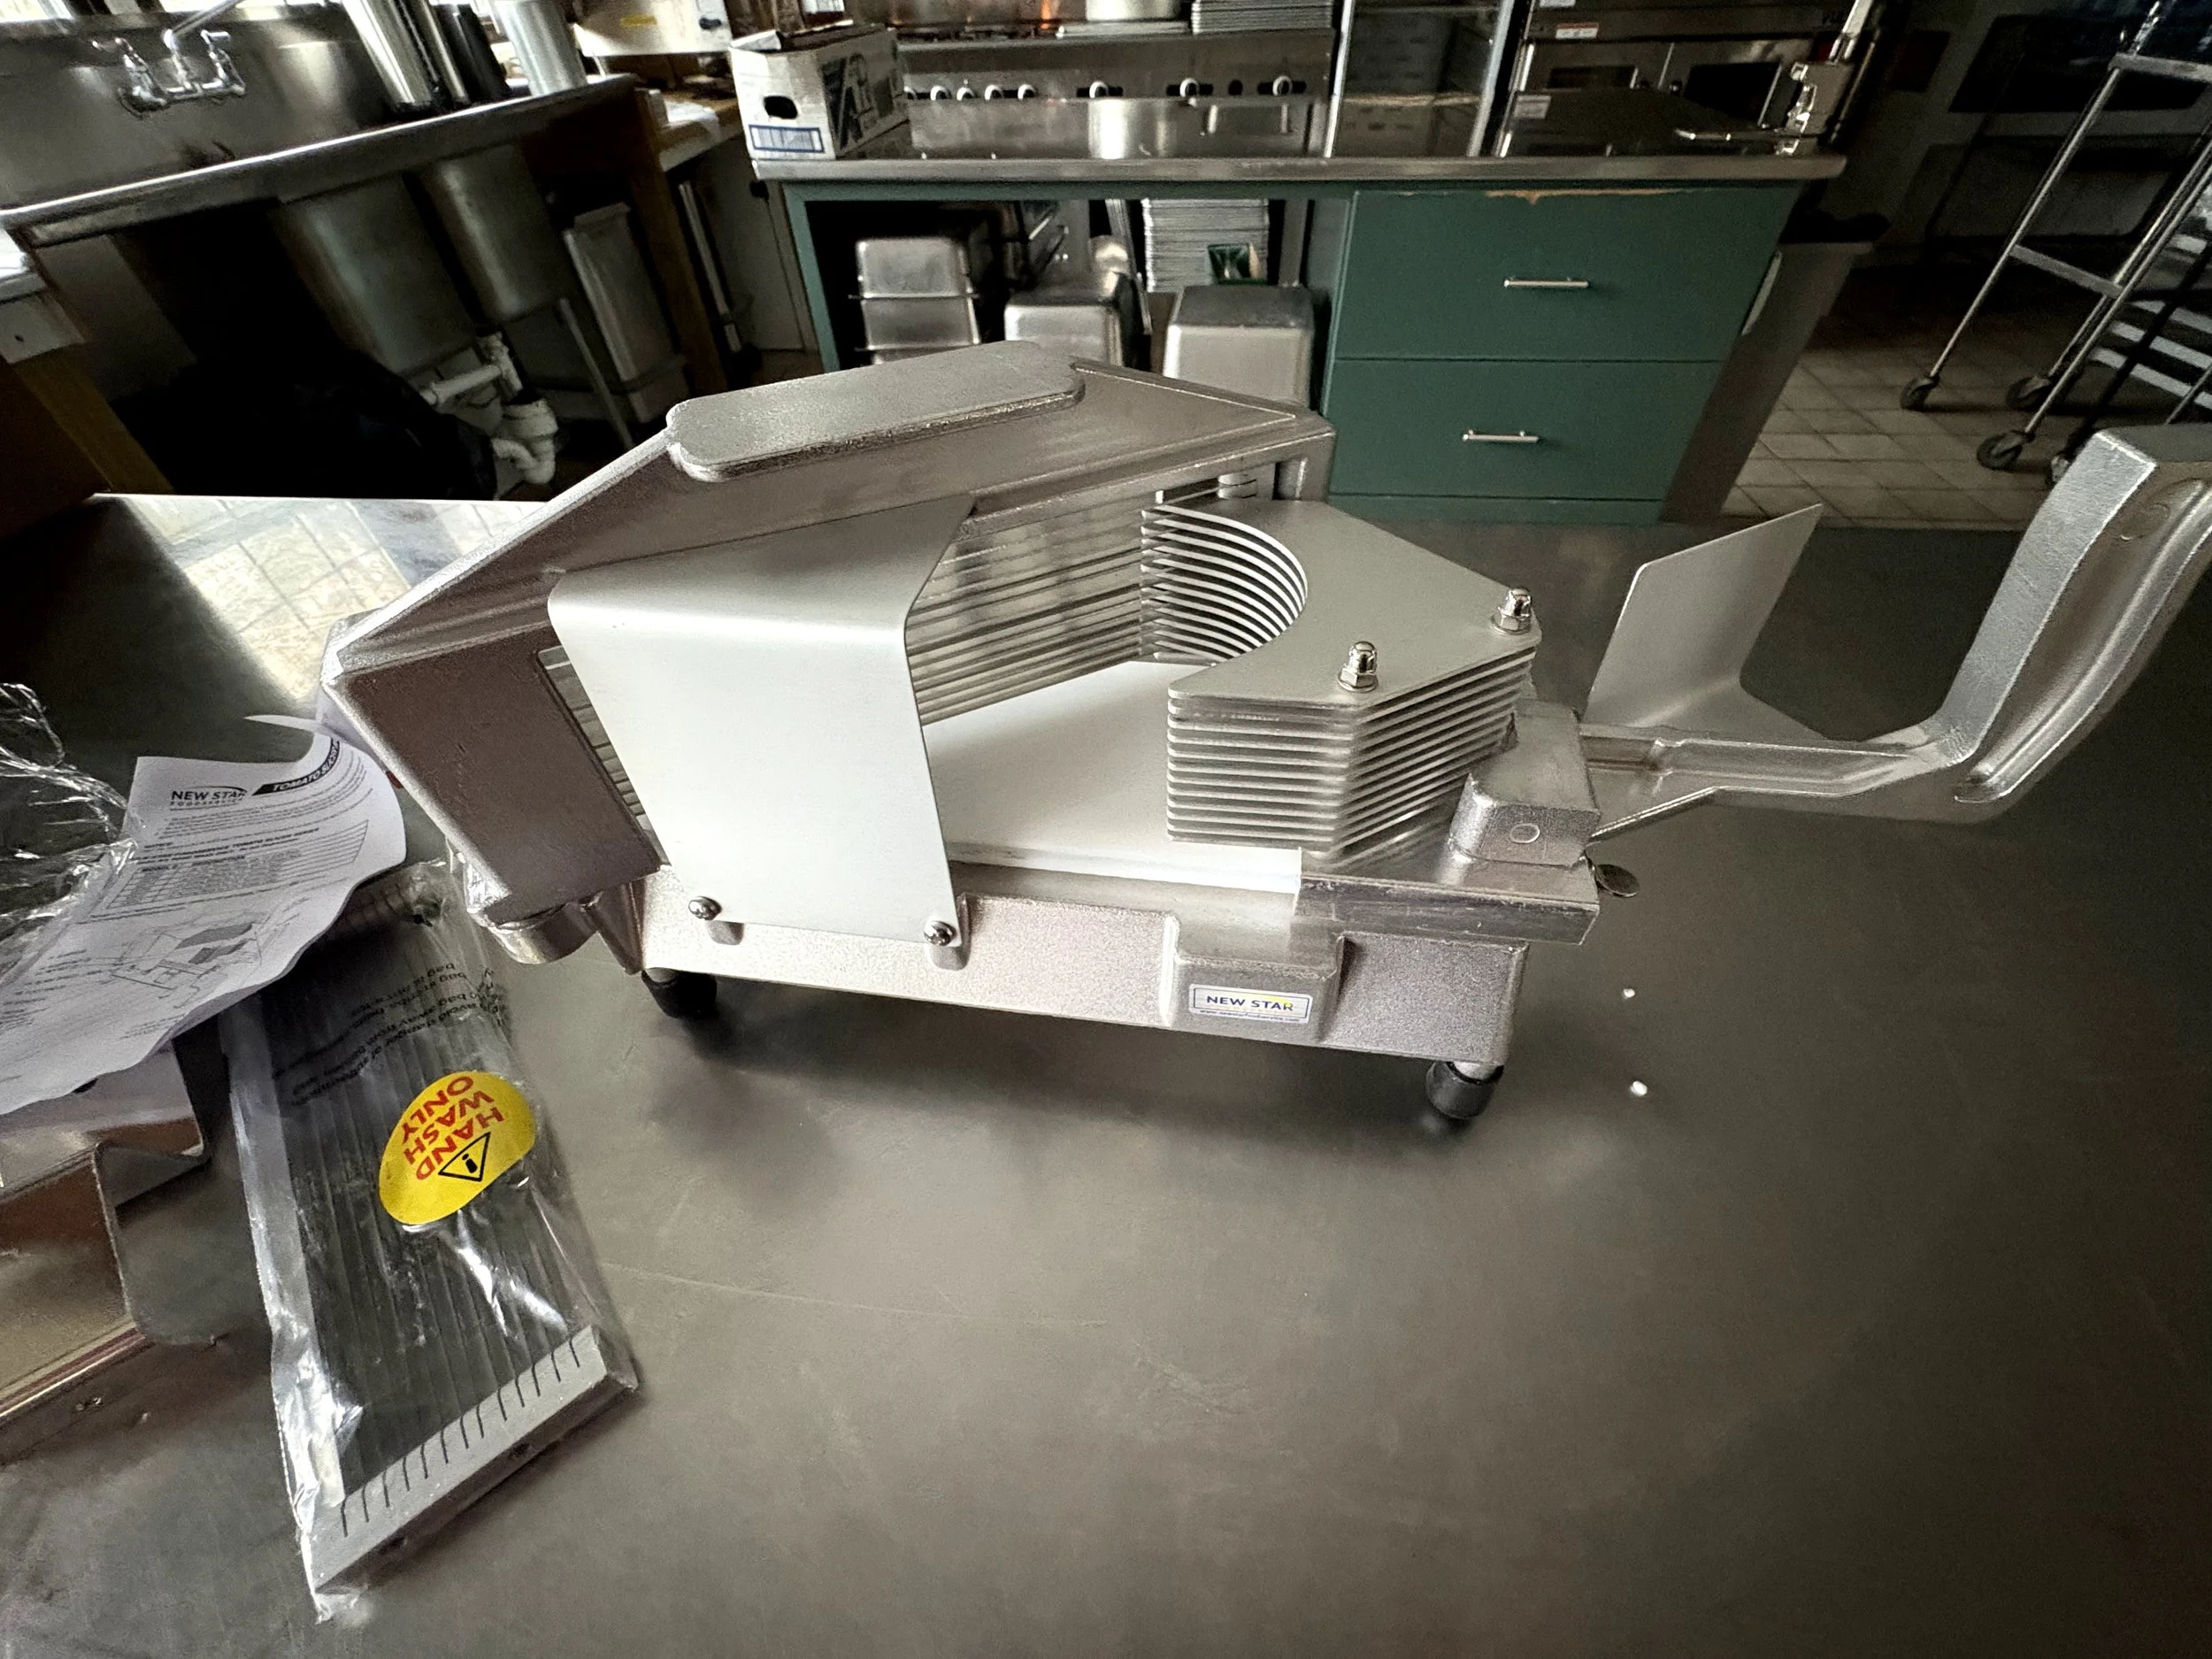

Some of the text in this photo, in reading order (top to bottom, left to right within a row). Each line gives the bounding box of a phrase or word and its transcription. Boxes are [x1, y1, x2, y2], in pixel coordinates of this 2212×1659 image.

[273, 770, 320, 791] TOMATO
[171, 790, 245, 801] NEW STAR
[427, 963, 455, 978] bag
[439, 972, 467, 984] bag
[438, 993, 466, 1007] bag
[1206, 995, 1246, 1007] NEW
[1251, 1000, 1294, 1011] STAR
[438, 1002, 477, 1020] avoid
[402, 1075, 474, 1143] ONLY
[403, 1090, 495, 1164] WASH
[416, 1108, 505, 1180] HAND
